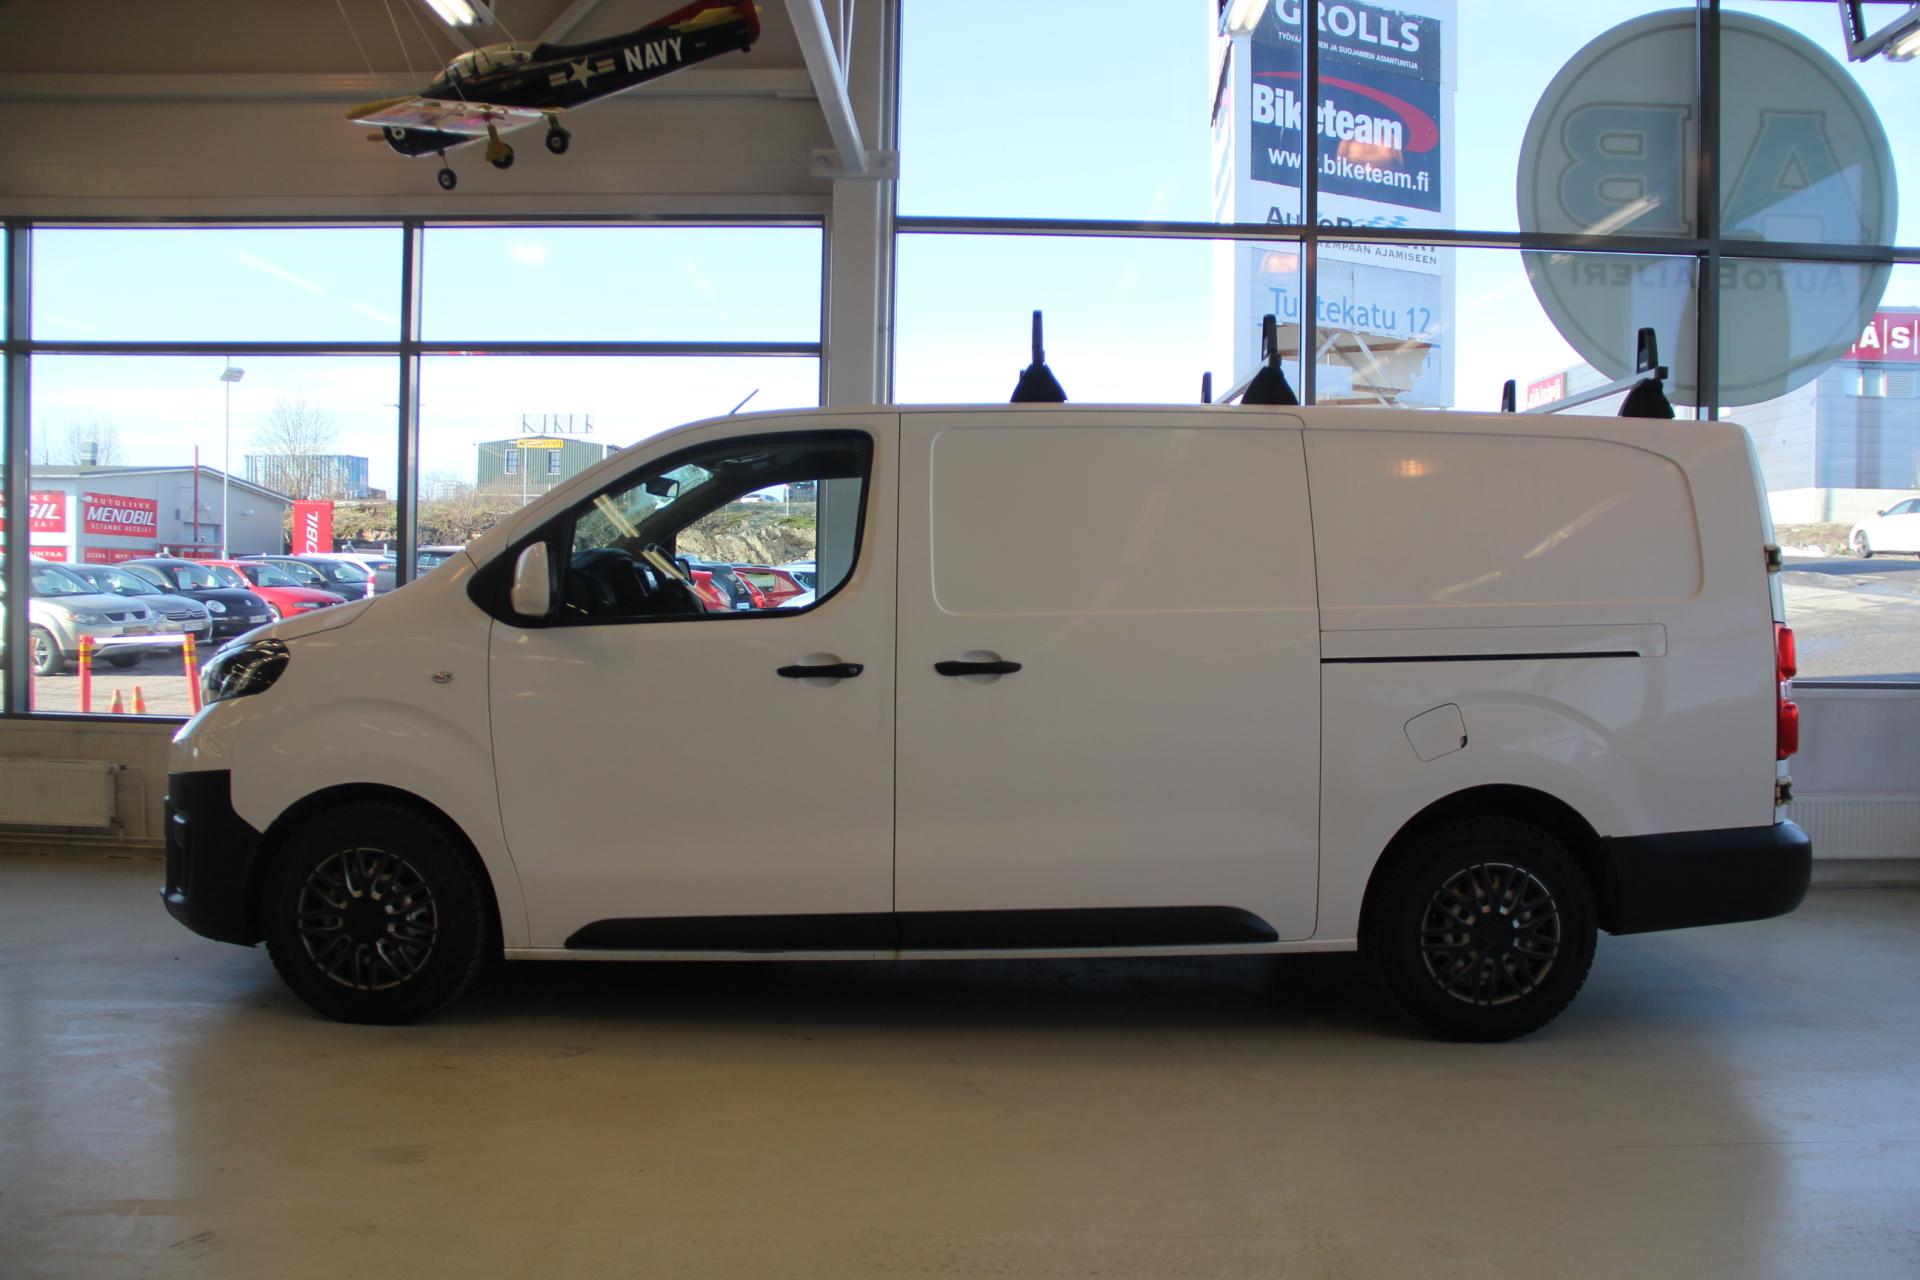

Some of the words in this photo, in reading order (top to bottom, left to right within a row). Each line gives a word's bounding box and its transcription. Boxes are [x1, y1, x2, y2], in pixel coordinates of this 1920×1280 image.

[622, 36, 685, 73] NAVY
[1268, 147, 1429, 192] ww.biketeam.fi
[1375, 248, 1437, 265] AJAMISEEN
[1269, 287, 1396, 331] Tutekatu
[1406, 305, 1432, 334] 12
[86, 506, 156, 526] MENOBIL
[93, 498, 152, 509] AUTOLIIKE
[306, 511, 319, 553] OBIL
